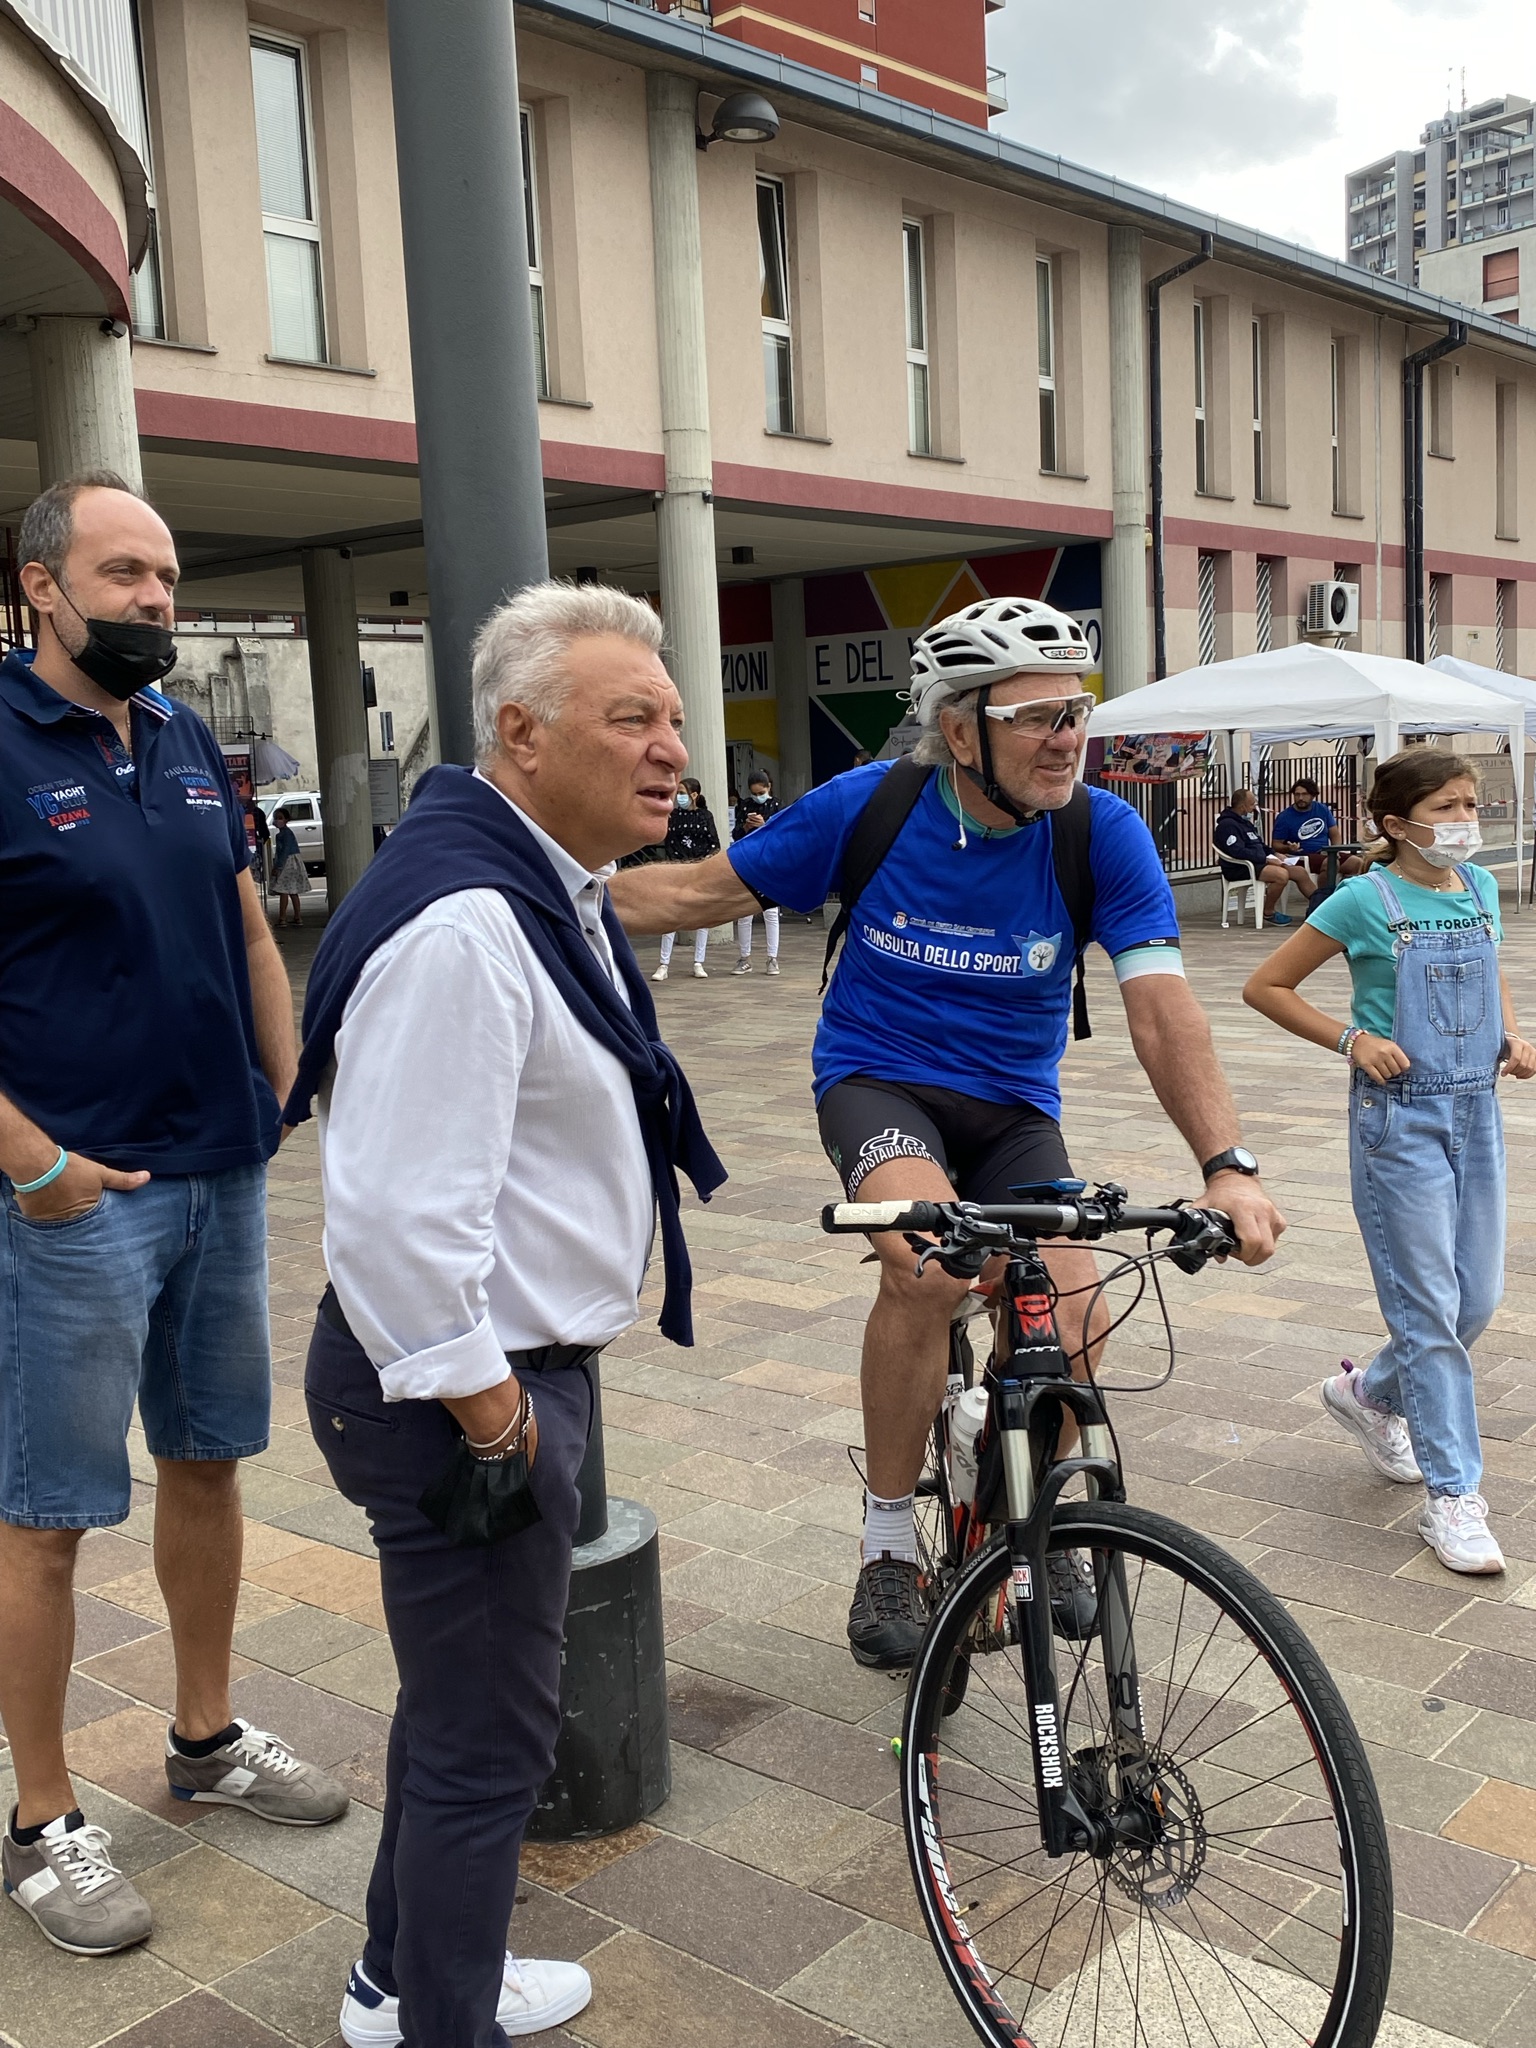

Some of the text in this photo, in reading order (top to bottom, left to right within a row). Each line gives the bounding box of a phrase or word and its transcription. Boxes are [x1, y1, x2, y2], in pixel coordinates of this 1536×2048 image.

[815, 644, 831, 685] E
[846, 640, 893, 684] DEL
[51, 785, 87, 802] YACHT
[54, 777, 75, 788] TEAM
[26, 792, 58, 819] YC
[61, 796, 88, 809] CLUB
[863, 924, 920, 960] CONSULTA
[924, 944, 970, 969] DELLO
[973, 952, 1020, 973] SPORT
[1034, 1703, 1063, 1788] ROCKSHOX
